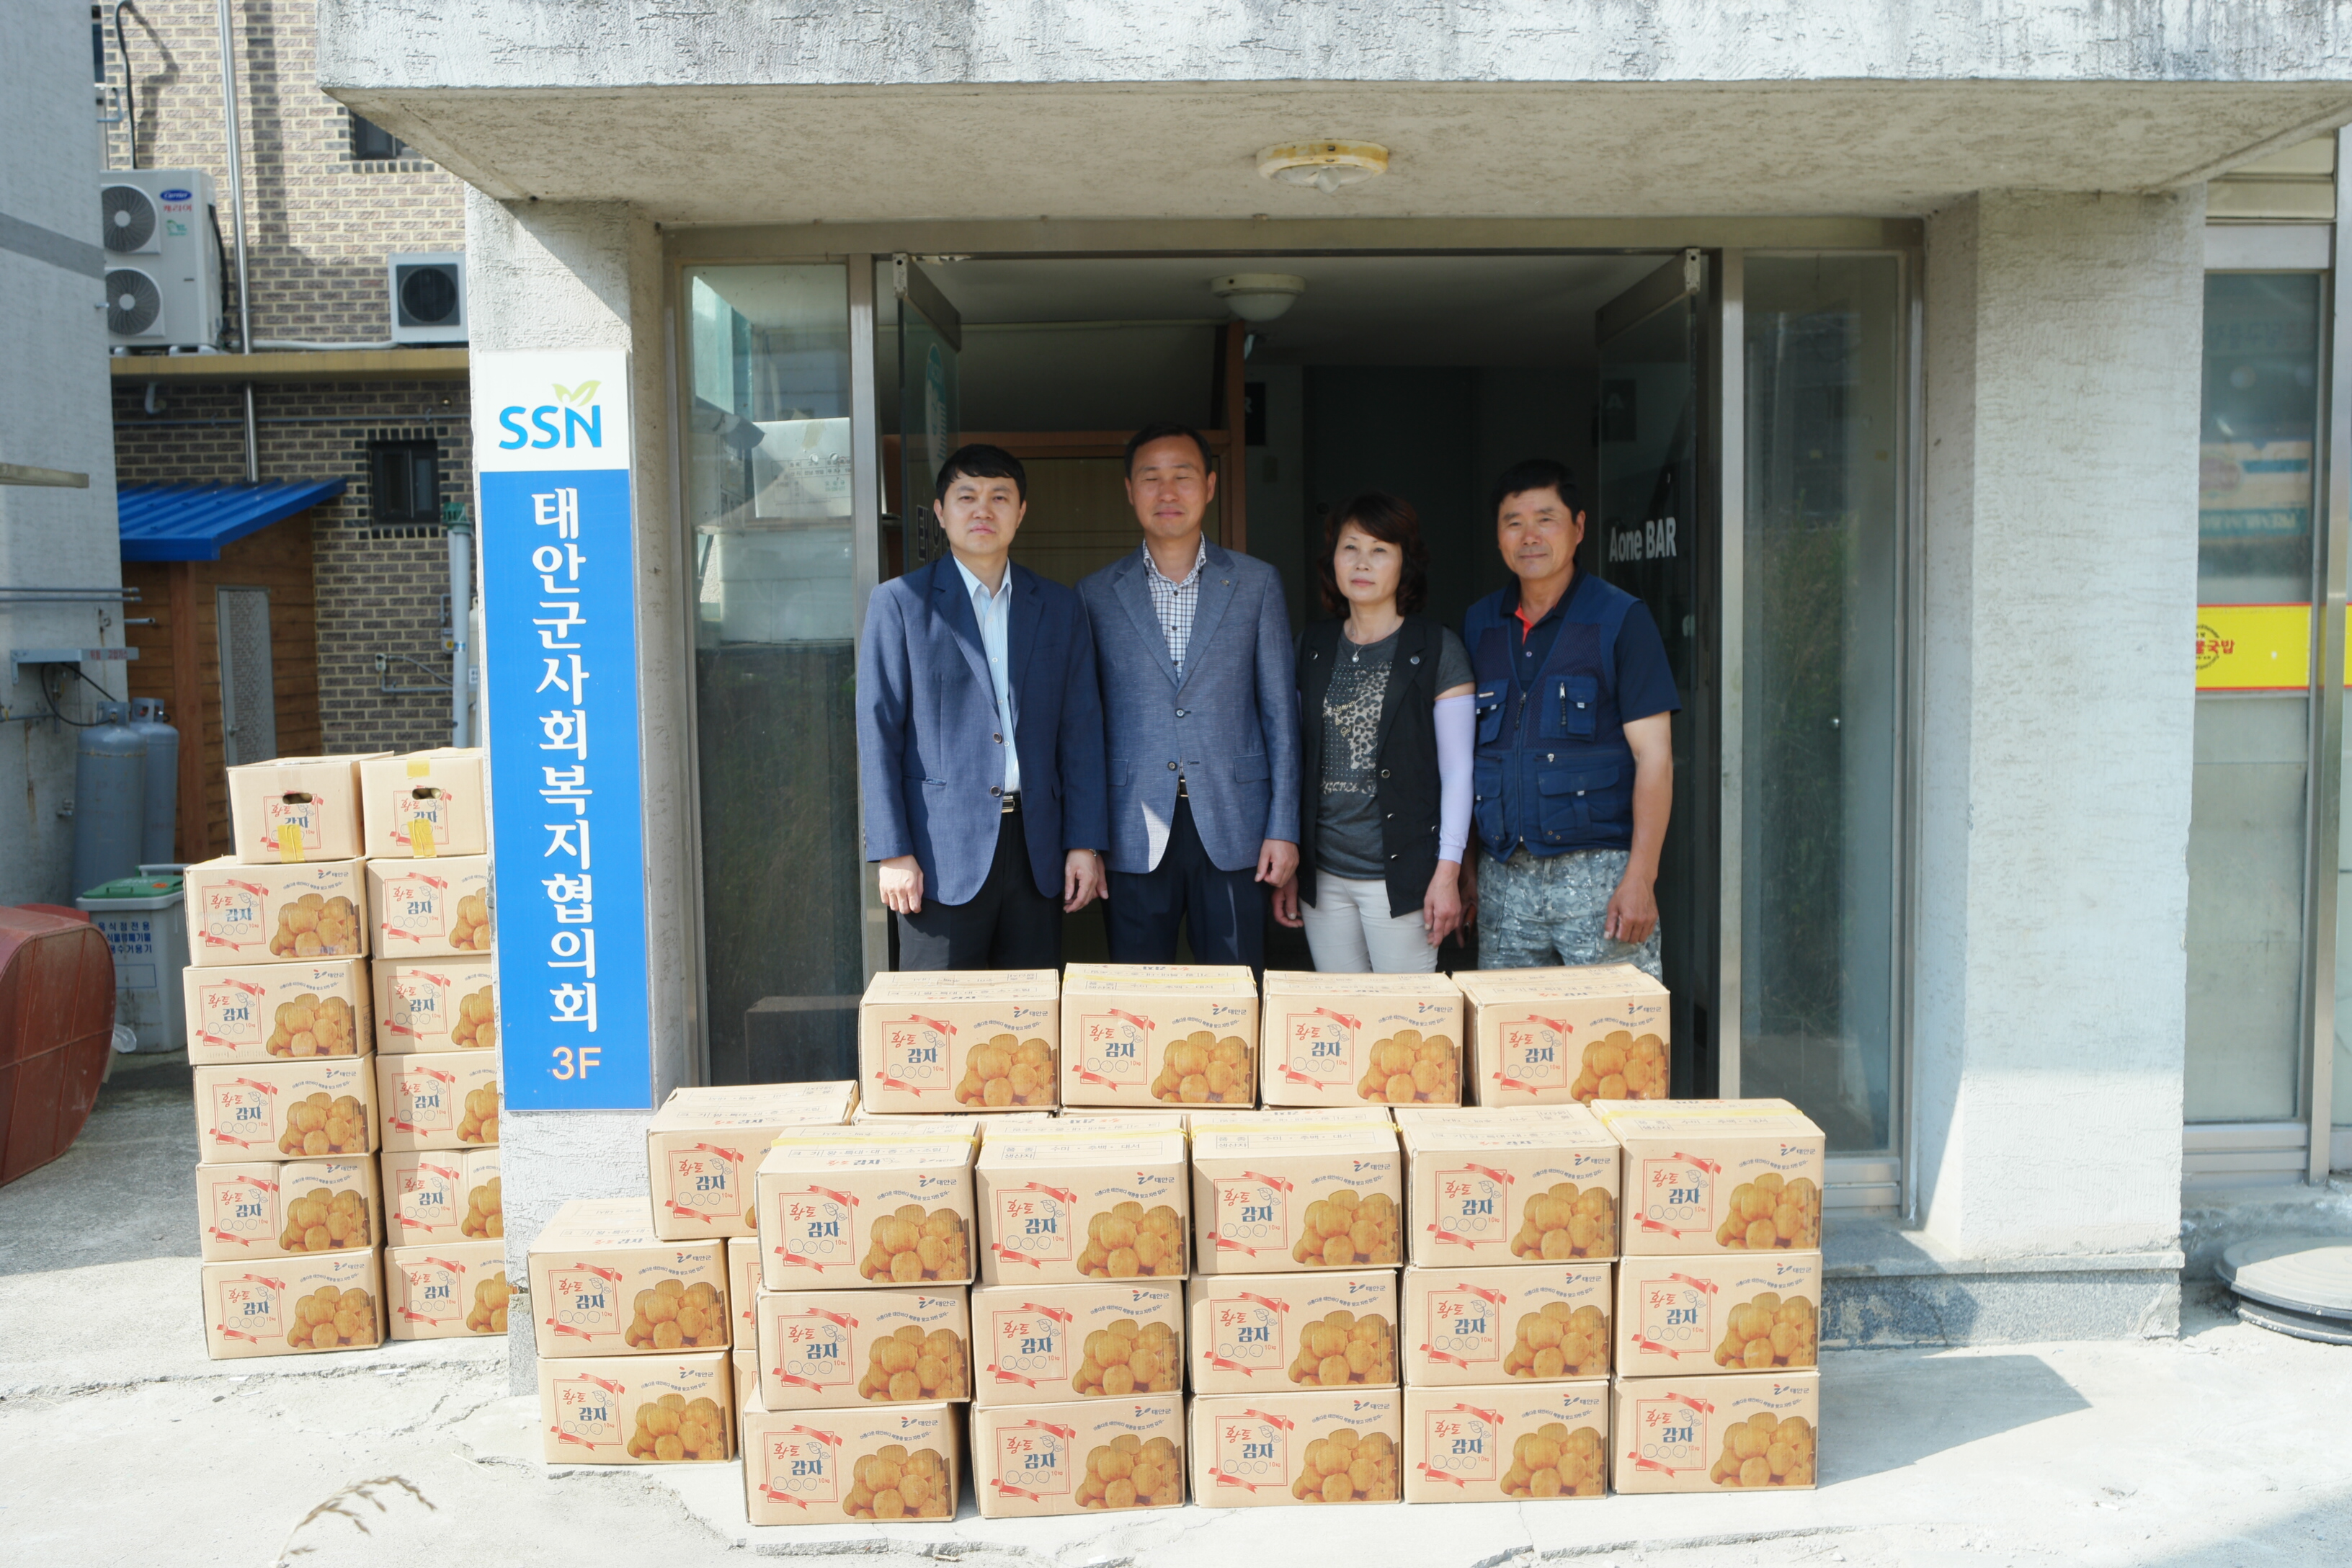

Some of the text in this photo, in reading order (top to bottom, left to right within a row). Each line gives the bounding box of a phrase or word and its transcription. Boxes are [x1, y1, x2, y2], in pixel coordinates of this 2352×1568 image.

[499, 405, 602, 450] SSN
[1609, 517, 1677, 563] Aone BAR
[531, 487, 597, 1033] 태안군사회복지협의회
[210, 893, 233, 909] 황토
[393, 886, 414, 901] 황토
[226, 909, 253, 922] 감자
[406, 901, 433, 914] 감자
[396, 984, 417, 999] 황토
[208, 992, 231, 1008] 황토
[409, 999, 436, 1012] 감자
[223, 1008, 250, 1022] 감자
[891, 1030, 917, 1048] 황토
[1090, 1024, 1115, 1042] 황토
[1296, 1023, 1321, 1041] 황토
[1509, 1030, 1534, 1048] 황토
[907, 1048, 938, 1064] 감자
[1105, 1043, 1136, 1058] 감자
[1311, 1042, 1342, 1057] 감자
[1525, 1048, 1555, 1063] 감자
[552, 1046, 601, 1080] 3F
[400, 1080, 422, 1096] 황토
[221, 1092, 243, 1108] 황토
[414, 1095, 440, 1108] 감자
[236, 1107, 262, 1121] 감자
[679, 1159, 704, 1176] 황토
[404, 1177, 426, 1193] 황토
[695, 1176, 726, 1191] 감자
[1652, 1169, 1679, 1188] 황토
[221, 1190, 244, 1205] 황토
[1224, 1188, 1251, 1206] 황토
[1445, 1180, 1472, 1199] 황토
[1668, 1188, 1701, 1205] 감자
[419, 1192, 445, 1206] 감자
[236, 1204, 263, 1218] 감자
[789, 1202, 816, 1221] 황토
[1007, 1199, 1034, 1218] 황토
[1241, 1206, 1274, 1223] 감자
[1461, 1199, 1494, 1216] 감자
[807, 1221, 840, 1238] 감자
[1025, 1218, 1058, 1234] 감자
[409, 1271, 432, 1286] 황토
[558, 1278, 584, 1295] 황토
[228, 1288, 251, 1303] 황토
[424, 1286, 450, 1298] 감자
[1650, 1290, 1677, 1309] 황토
[243, 1302, 270, 1315] 감자
[575, 1295, 606, 1309] 감자
[1438, 1300, 1464, 1319] 황토
[1221, 1309, 1247, 1327] 황토
[1666, 1309, 1698, 1325] 감자
[788, 1324, 816, 1343] 황토
[1003, 1319, 1030, 1338] 황토
[1237, 1327, 1270, 1342] 감자
[1454, 1319, 1487, 1335] 감자
[806, 1343, 839, 1359] 감자
[1020, 1338, 1054, 1354] 감자
[562, 1389, 587, 1406] 황토
[579, 1406, 609, 1420] 감자
[1646, 1409, 1672, 1427] 황토
[1225, 1425, 1252, 1443] 황토
[1435, 1420, 1461, 1438] 황토
[1662, 1427, 1694, 1443] 감자
[773, 1441, 801, 1460] 황토
[1007, 1436, 1033, 1454] 황토
[1242, 1443, 1275, 1459] 감자
[1451, 1438, 1484, 1454] 감자
[790, 1460, 824, 1476] 감자
[1023, 1453, 1056, 1469] 감자
